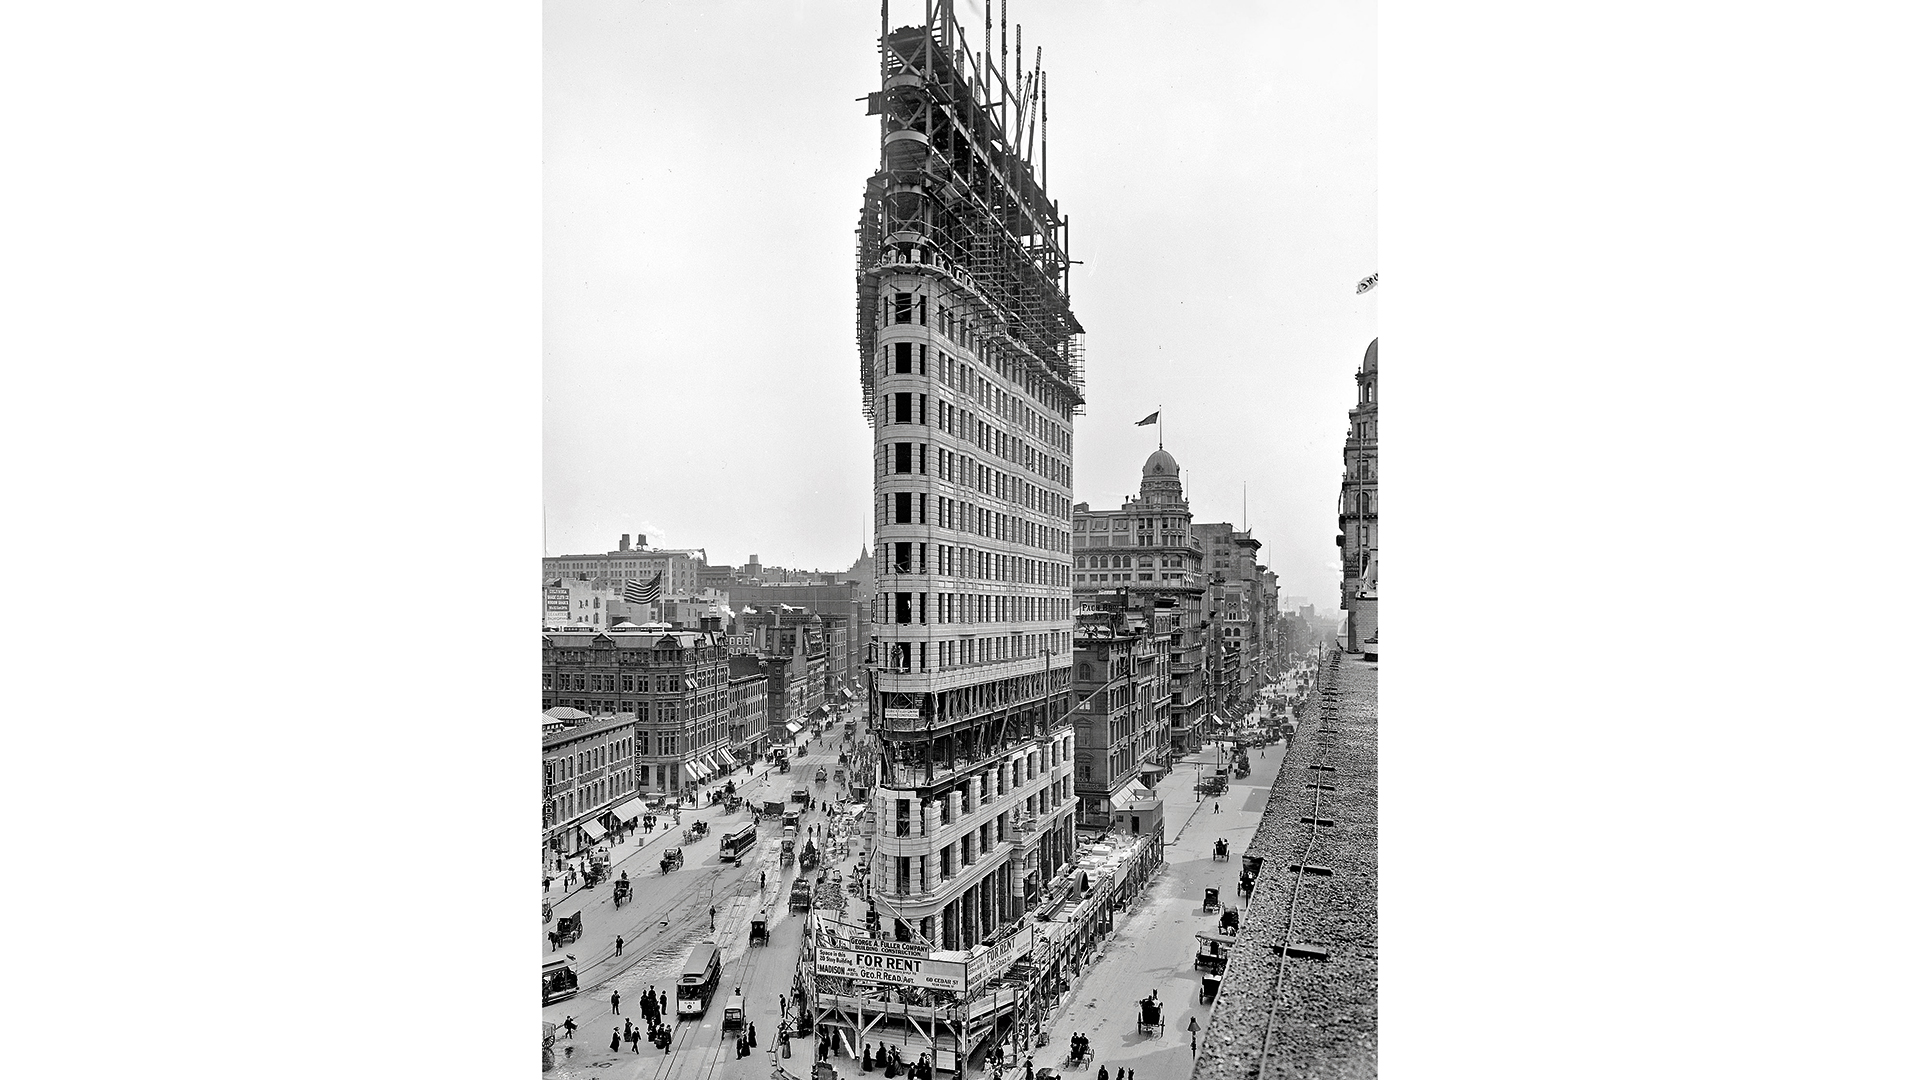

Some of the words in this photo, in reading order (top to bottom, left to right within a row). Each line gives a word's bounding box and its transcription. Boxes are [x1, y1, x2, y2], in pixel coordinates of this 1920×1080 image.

[851, 938, 872, 947] GEORGE
[881, 941, 900, 949] FULLER
[902, 943, 928, 953] COMPANY
[987, 947, 999, 963] FOR
[1000, 937, 1015, 955] RENT
[820, 964, 845, 975] MADISON
[856, 953, 882, 968] FOR
[886, 957, 921, 972] RENT
[934, 977, 951, 985] CEDAR
